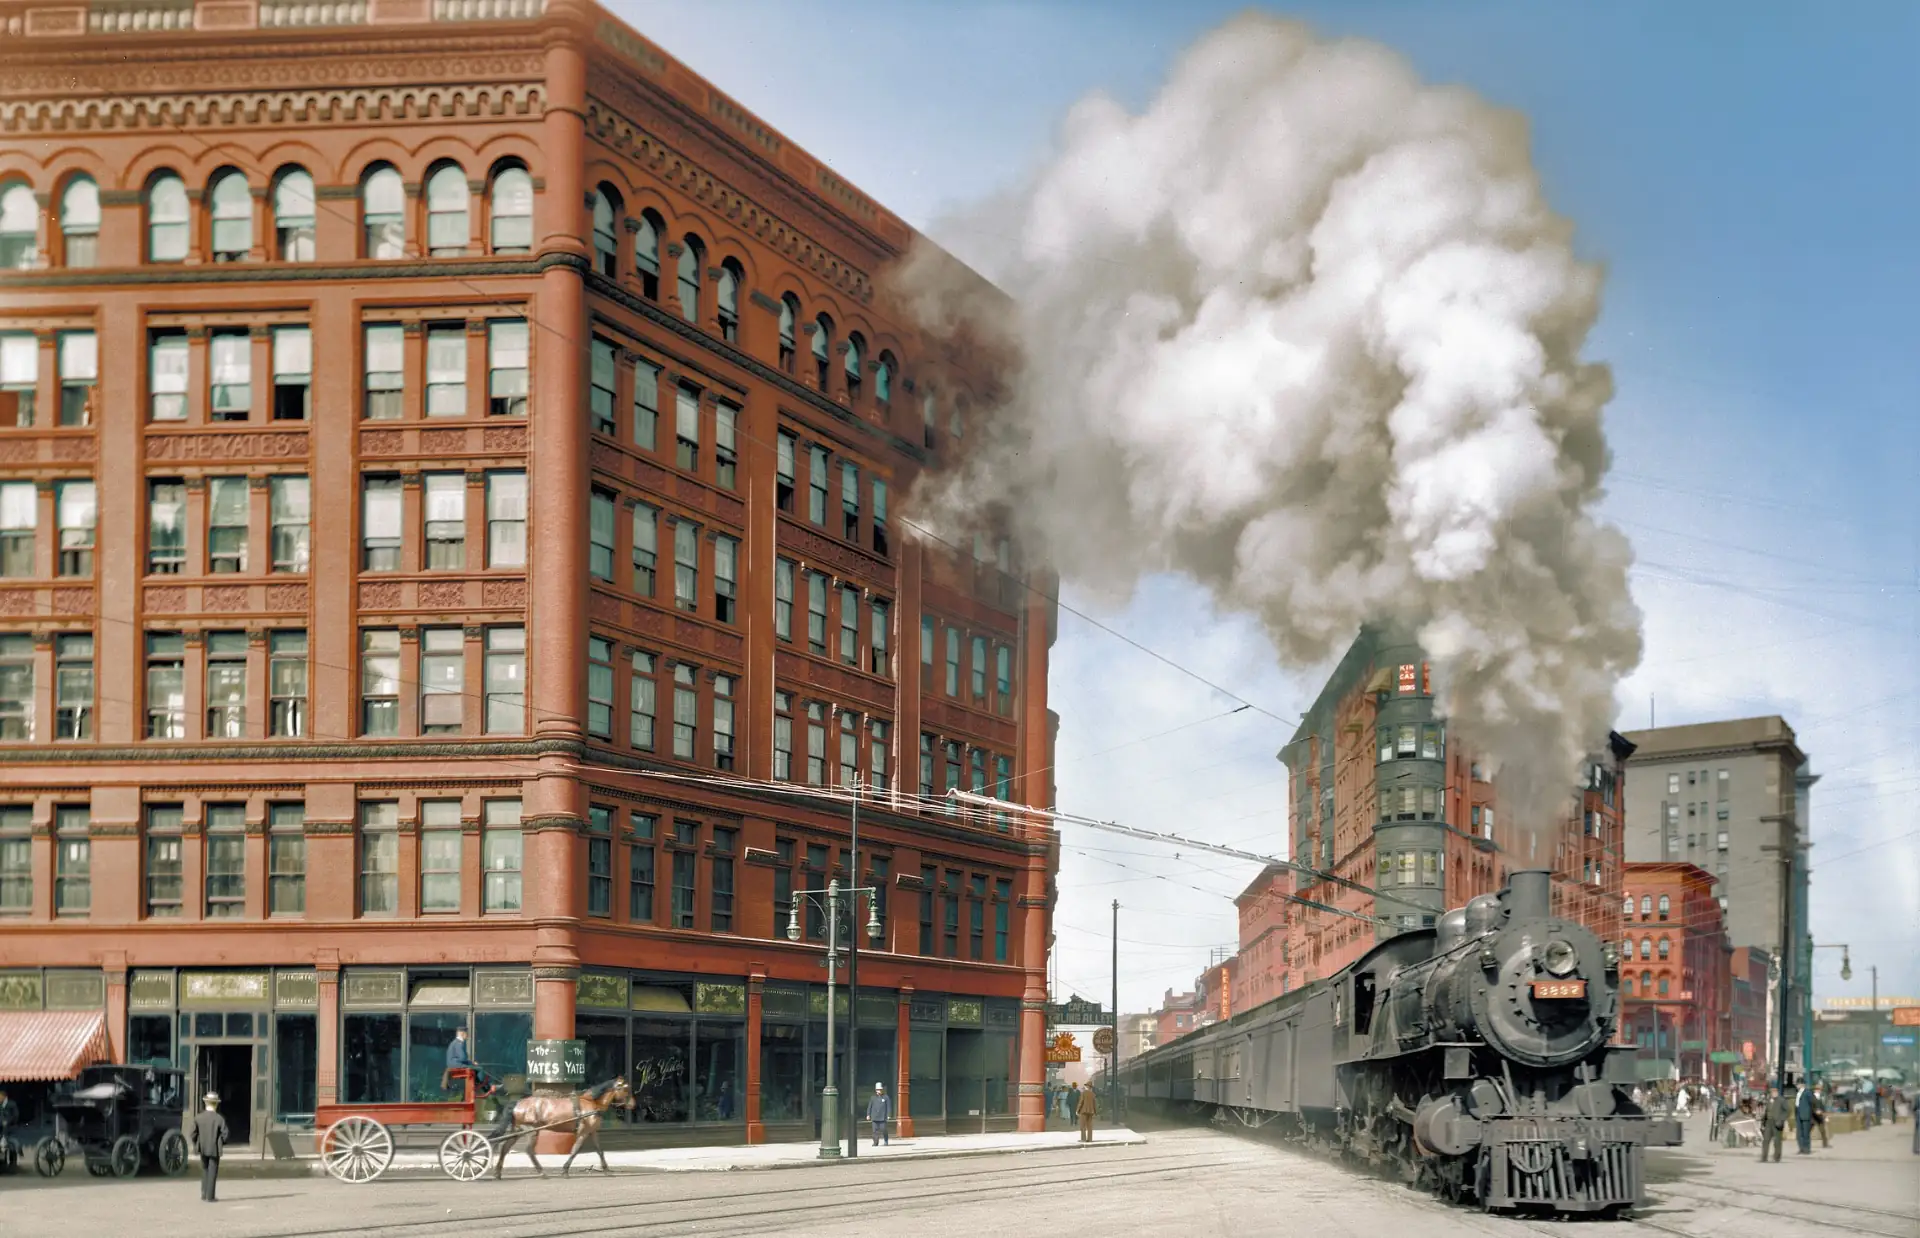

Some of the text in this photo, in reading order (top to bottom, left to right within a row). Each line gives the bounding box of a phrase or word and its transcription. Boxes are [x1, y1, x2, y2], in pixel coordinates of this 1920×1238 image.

[165, 433, 291, 460] THE YATES
[535, 1045, 550, 1057] The
[527, 1060, 560, 1075] YATES
